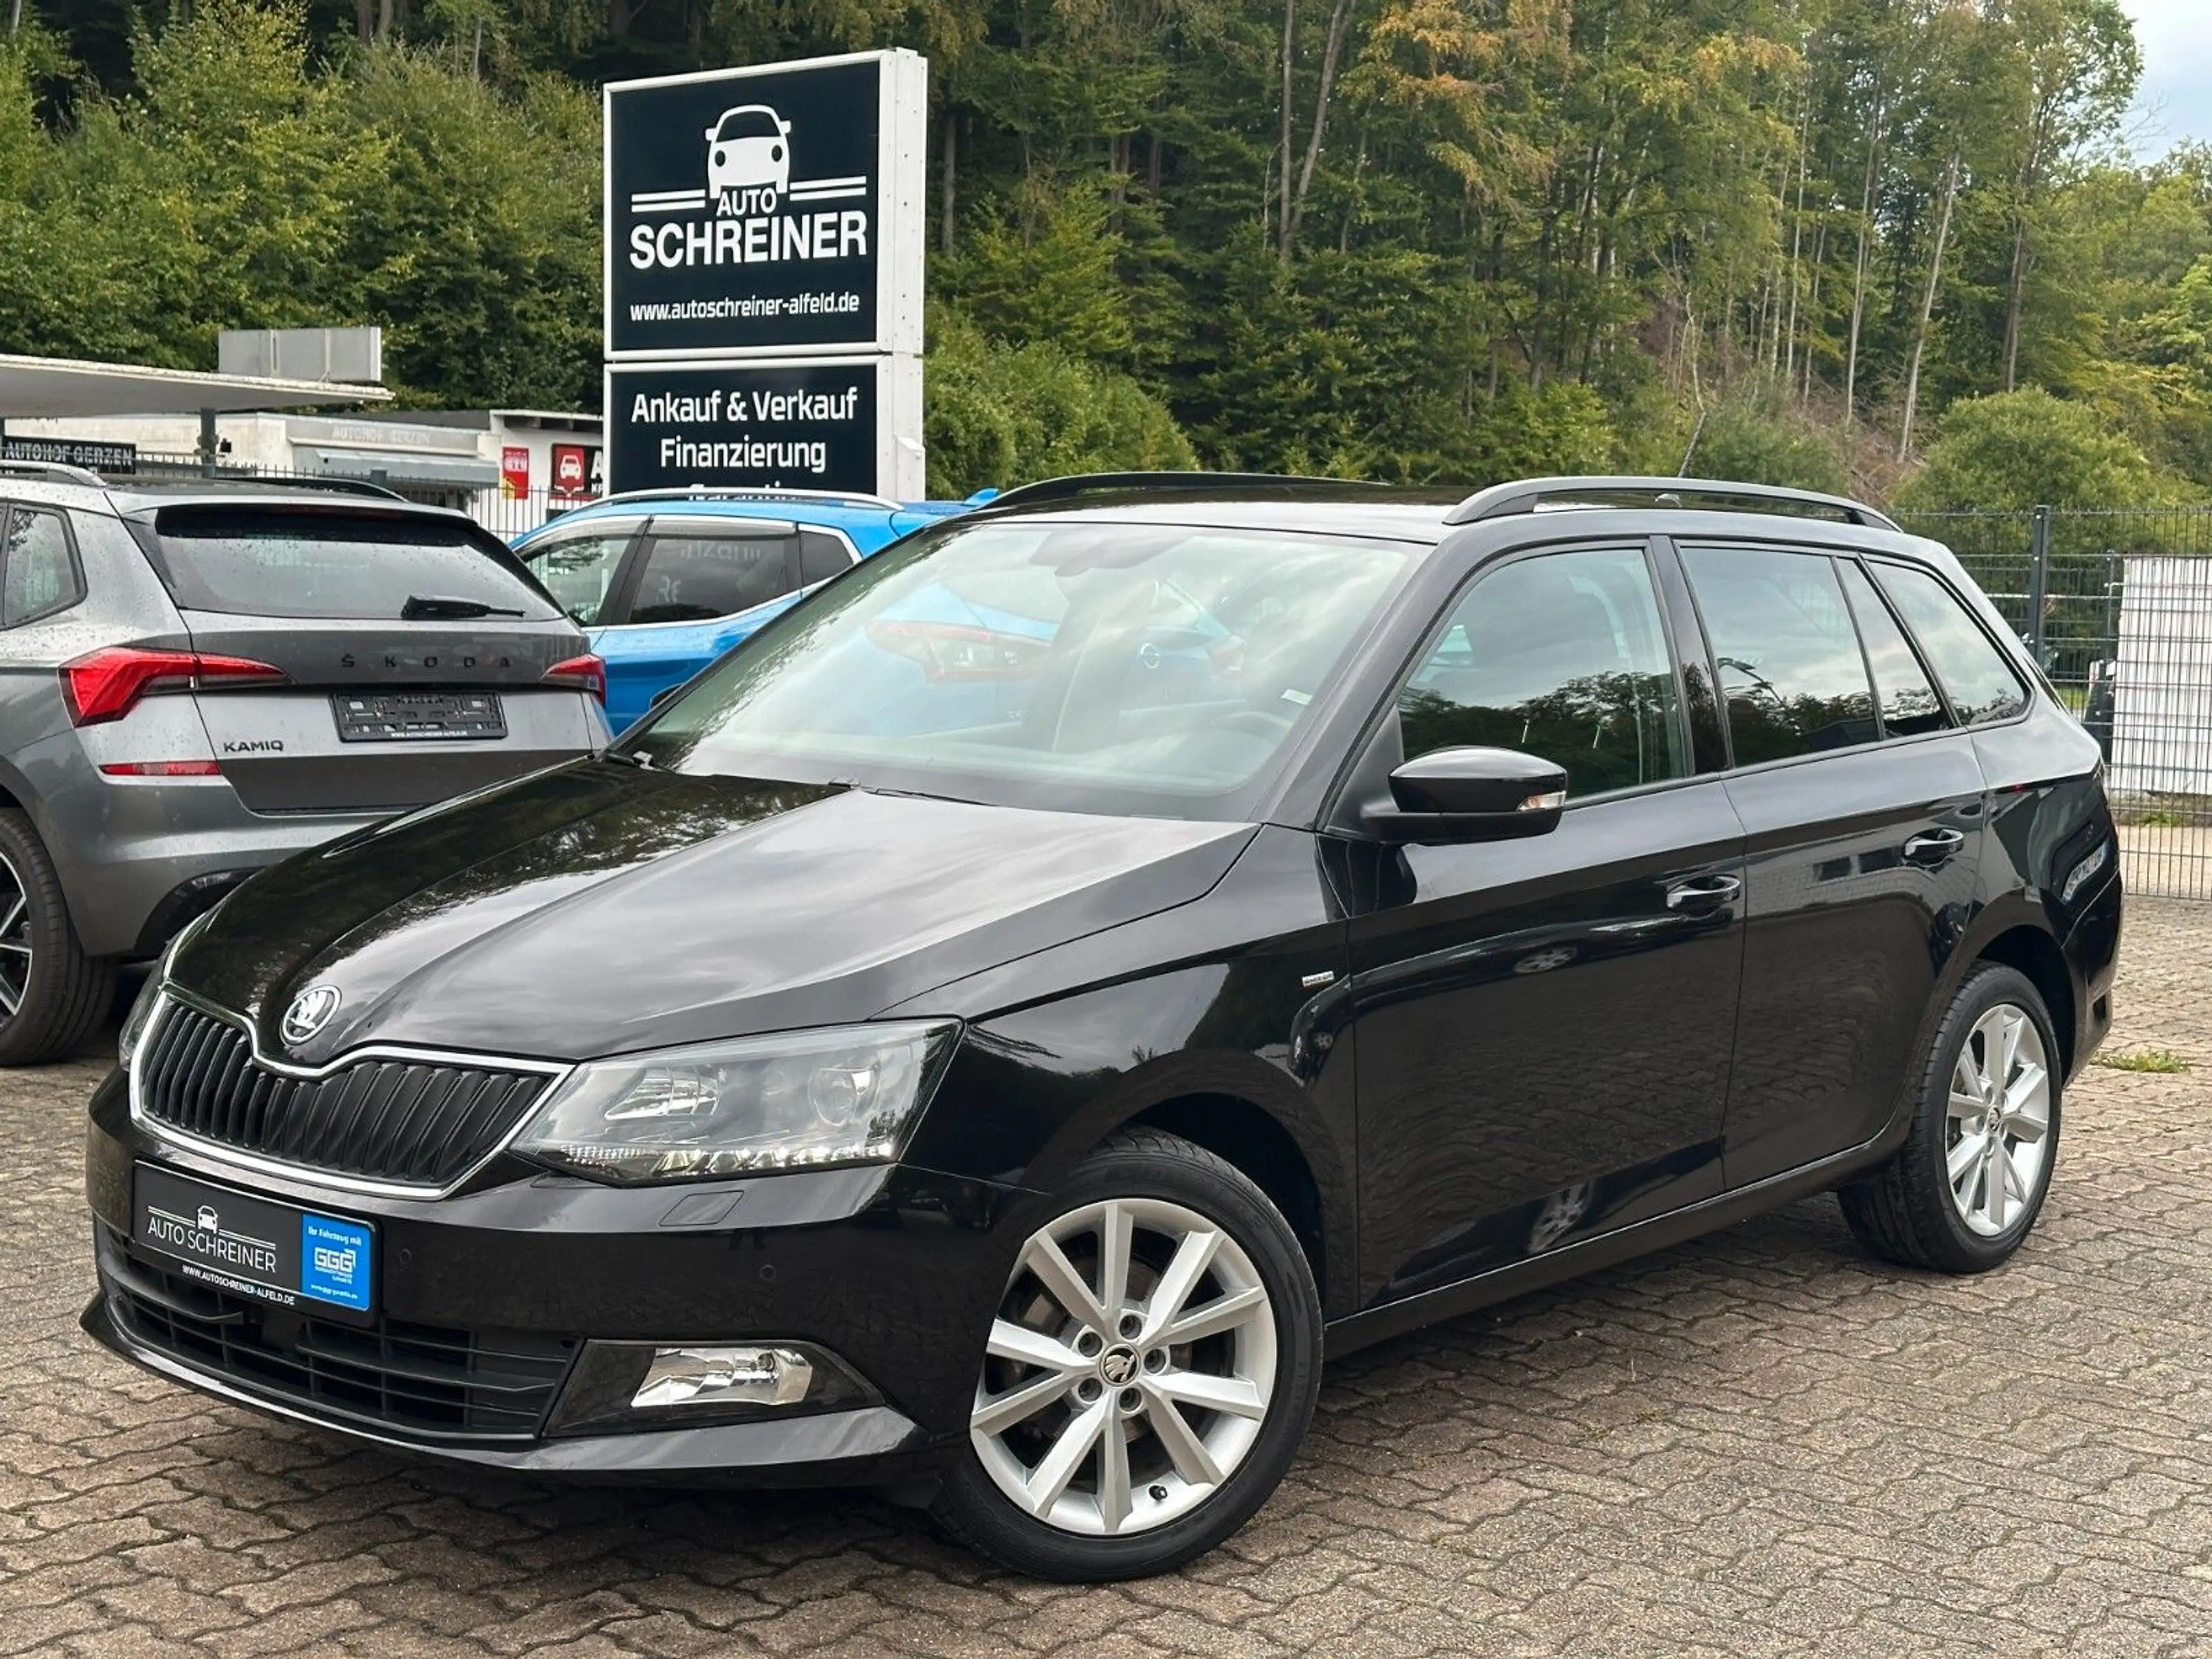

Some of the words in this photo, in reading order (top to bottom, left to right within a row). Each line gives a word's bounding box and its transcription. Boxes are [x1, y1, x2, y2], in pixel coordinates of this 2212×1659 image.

[716, 187, 778, 217] AUTO
[630, 210, 867, 269] SCHREINER
[630, 291, 859, 321] www.autoschreiner-alfeld.de
[631, 391, 721, 422] Ankauf
[727, 392, 748, 421] &
[753, 387, 858, 421] Verkauf
[5, 441, 70, 462] AUTOHOF
[74, 446, 132, 466] GERZEN
[661, 435, 826, 473] Finanzierung
[223, 740, 284, 752] KAMIQ
[147, 1217, 184, 1245] AUTO
[188, 1230, 276, 1273] SCHREINER
[315, 1247, 354, 1273] GGG
[182, 1264, 296, 1306] WWW.AUTOSCHREINER-ALFELD.DE
